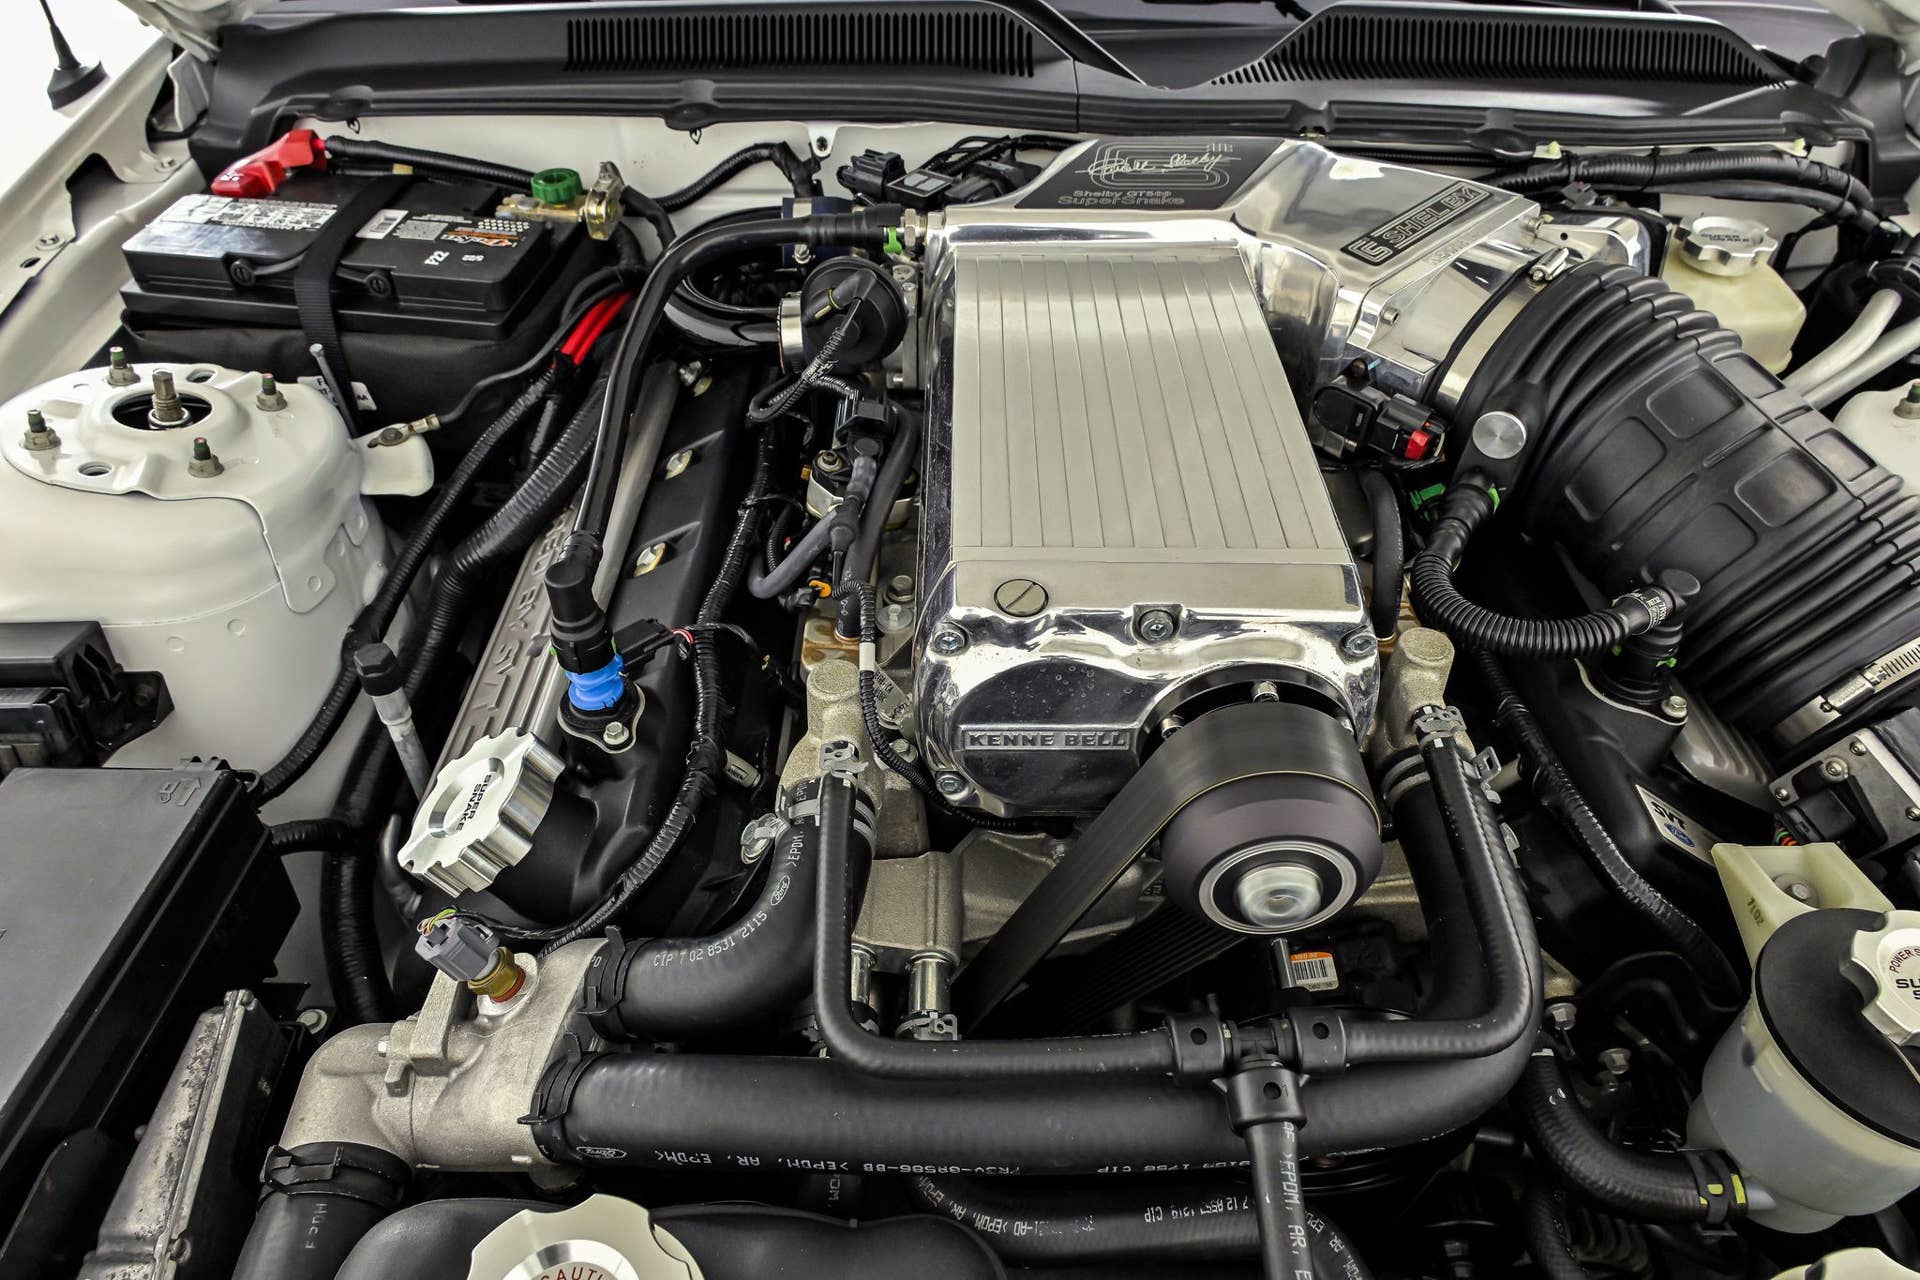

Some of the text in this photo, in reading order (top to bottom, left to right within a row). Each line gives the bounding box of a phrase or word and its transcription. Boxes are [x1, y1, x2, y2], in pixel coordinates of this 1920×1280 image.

[1073, 190, 1123, 198] Shelby
[1382, 186, 1478, 244] SHELBY
[968, 731, 1126, 747] KENNE BELL
[456, 783, 482, 831] SNAKE
[468, 774, 492, 819] SUPER
[1651, 801, 1685, 830] SVT
[653, 953, 673, 967] CIP
[689, 947, 704, 962] 02
[708, 935, 736, 957] 8531
[740, 910, 768, 938] 2115
[1889, 948, 1915, 974] POWER
[1144, 1206, 1163, 1223] CIP
